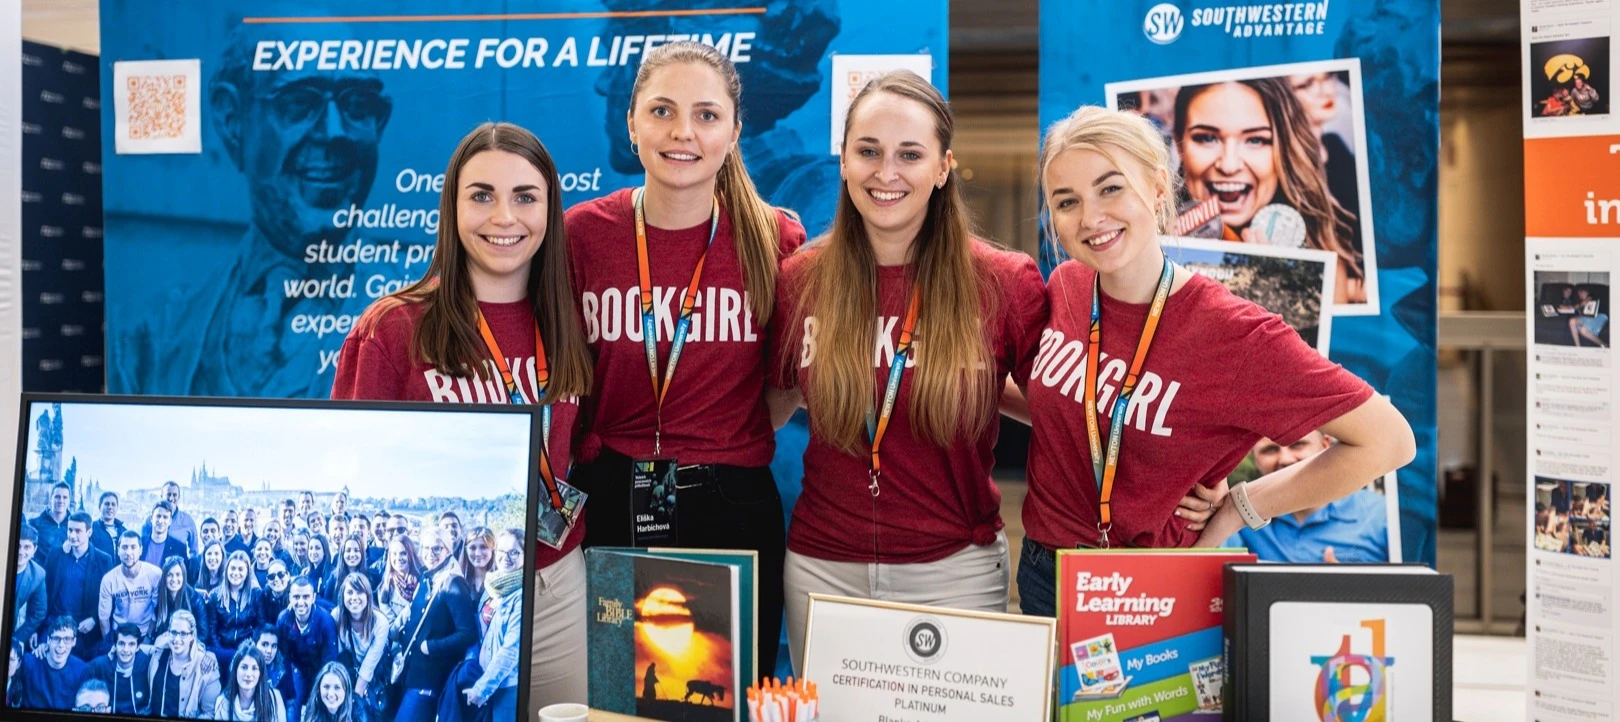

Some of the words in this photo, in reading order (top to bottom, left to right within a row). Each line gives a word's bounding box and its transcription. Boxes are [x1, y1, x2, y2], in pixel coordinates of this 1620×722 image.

[1191, 0, 1329, 33] SOUTHWESTERN
[1233, 21, 1325, 38] ADVANTAGE
[252, 38, 470, 71] EXPERIENCE
[475, 37, 547, 69] FOR
[553, 36, 579, 67] A
[587, 32, 756, 67] LIFEME
[395, 168, 446, 193] One
[557, 167, 602, 191] ost
[333, 203, 440, 234] challeng
[304, 240, 400, 264] student
[284, 274, 357, 298] world.
[291, 314, 360, 339] exper
[582, 286, 757, 343] BOOKGIRL
[1031, 328, 1181, 437] BOOKGRL
[1108, 435, 1118, 466] NEWTON
[1113, 402, 1126, 435] University
[1075, 571, 1133, 596] Early
[1075, 592, 1176, 617] Learning
[1106, 614, 1158, 626] LIBRARY
[841, 658, 941, 681] SOUTHWESTERN
[944, 671, 1008, 689] COMPANY
[1127, 657, 1143, 671] My
[1146, 650, 1178, 665] Books
[832, 674, 905, 693] CERTIFICATION
[908, 684, 918, 694] IN
[921, 685, 976, 703] PERSONAL
[980, 692, 1015, 707] SALES
[895, 698, 946, 714] PLATINUM
[1087, 708, 1102, 722] My
[1106, 702, 1127, 717] Fun
[1128, 695, 1152, 712] with
[1154, 686, 1188, 703] Words
